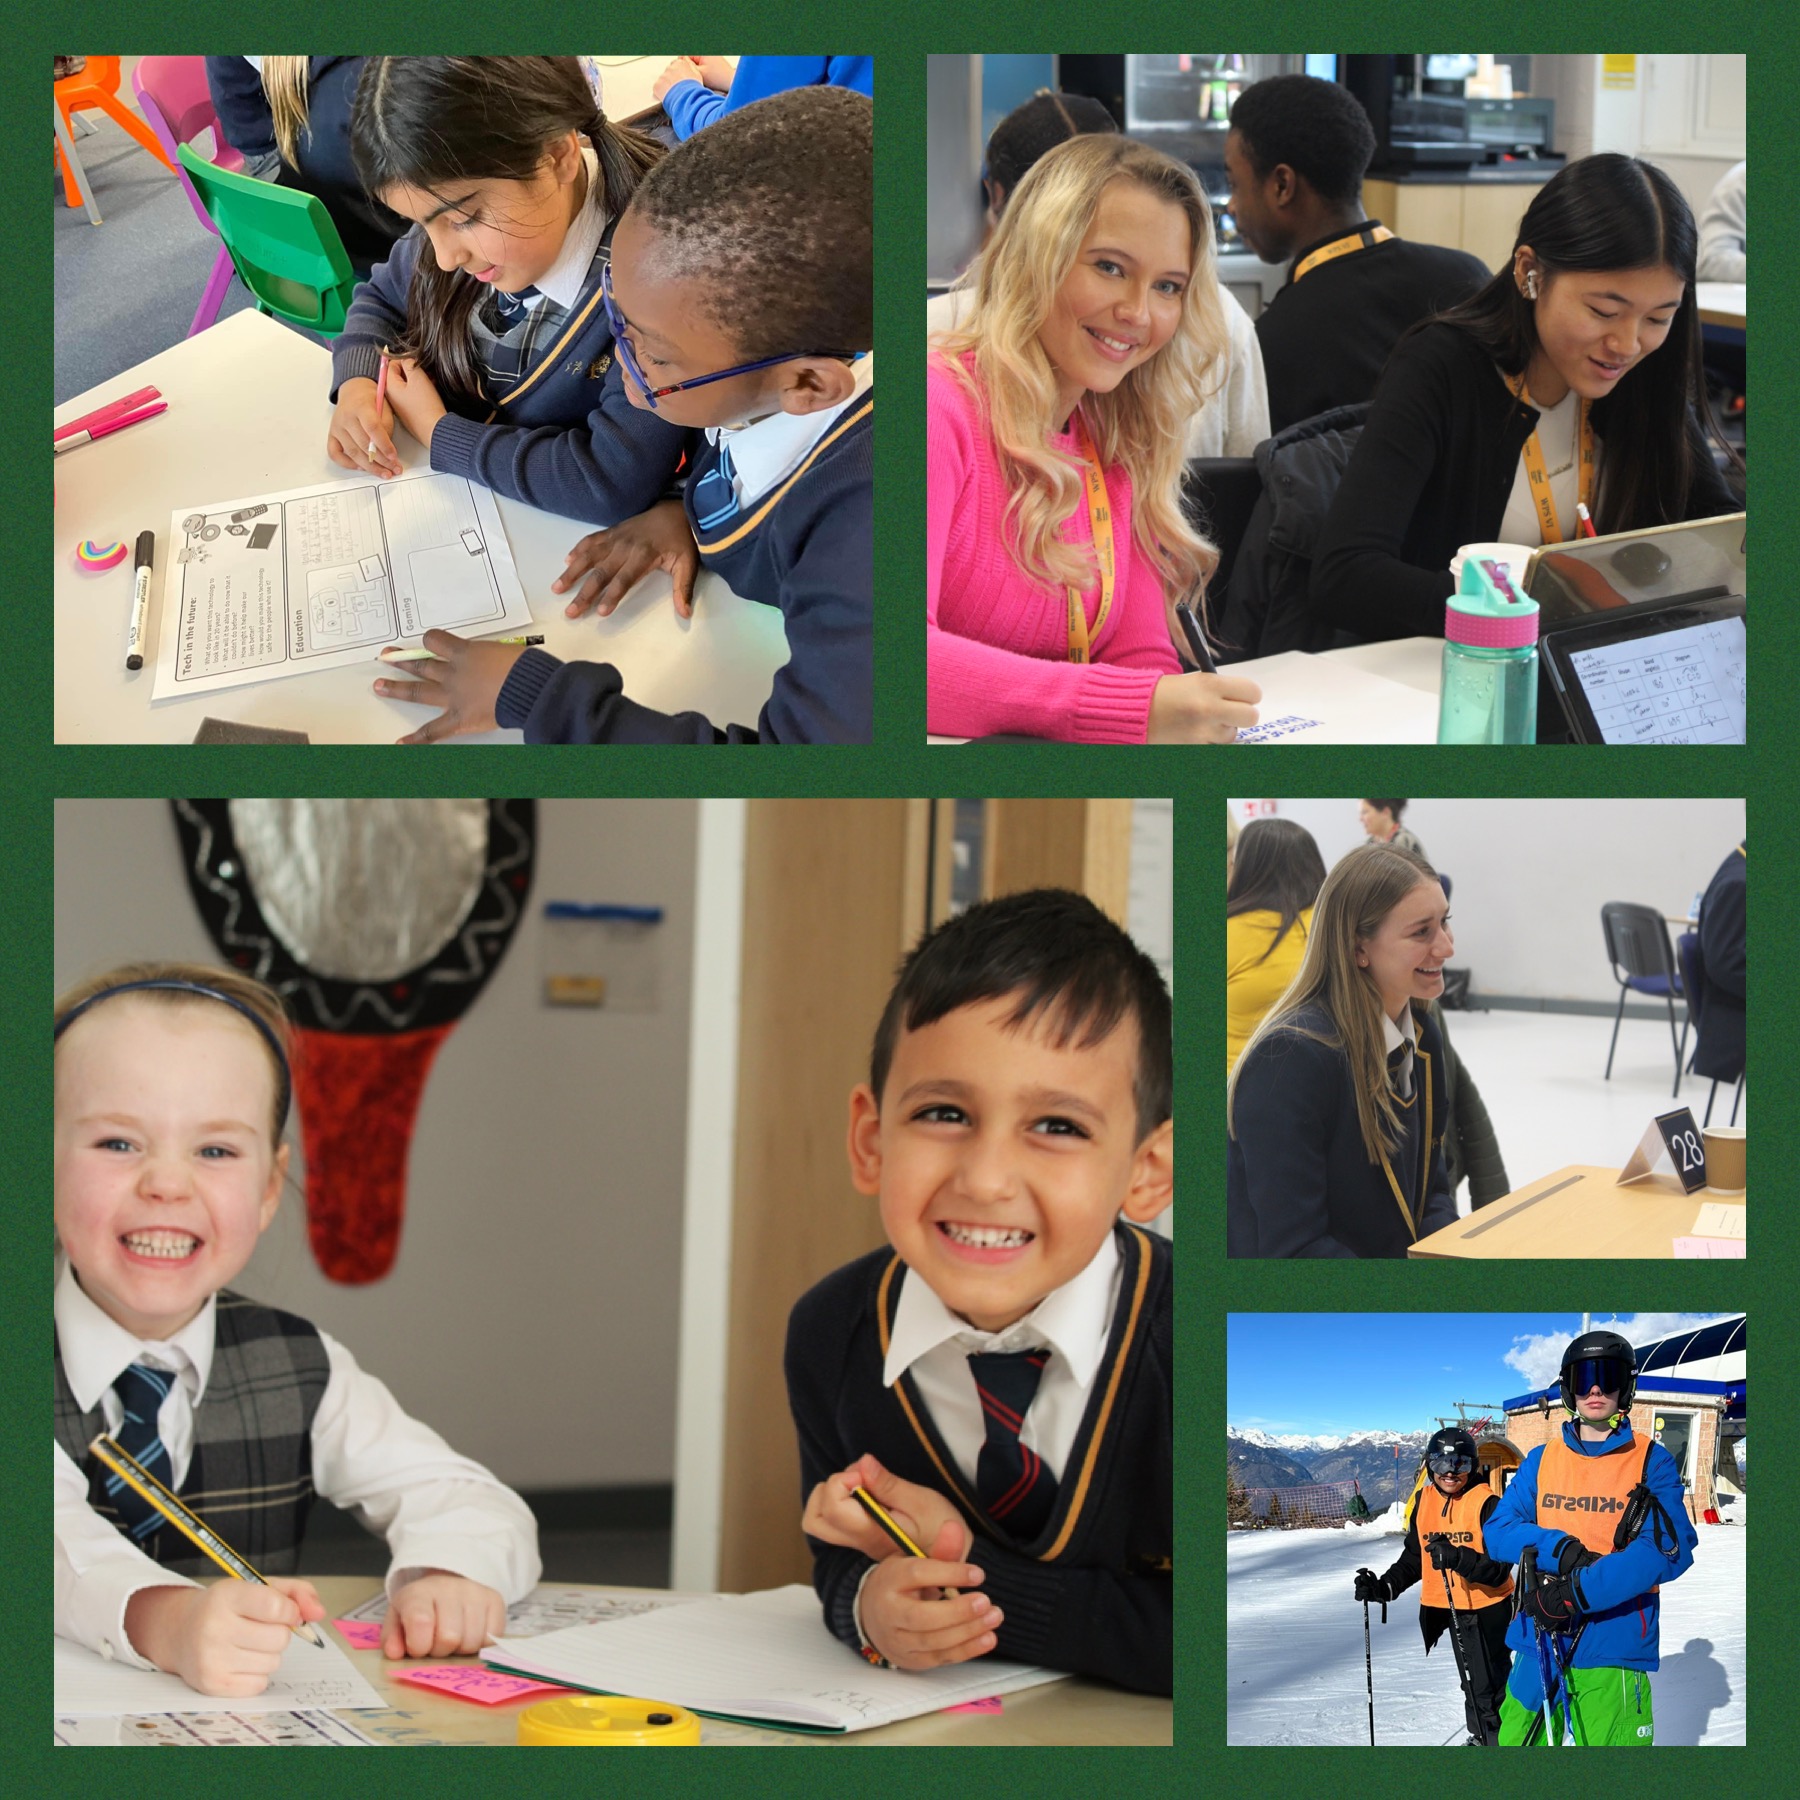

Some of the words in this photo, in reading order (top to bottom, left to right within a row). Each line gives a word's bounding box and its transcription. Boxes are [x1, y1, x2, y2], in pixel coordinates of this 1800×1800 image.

[1540, 497, 1551, 519] WPS
[187, 597, 197, 624] future:
[402, 597, 414, 631] Gaming
[185, 626, 195, 640] the
[293, 609, 304, 653] Education
[183, 642, 193, 652] in
[205, 643, 212, 651] do
[182, 653, 193, 675] Tech
[1672, 1130, 1704, 1172] 28
